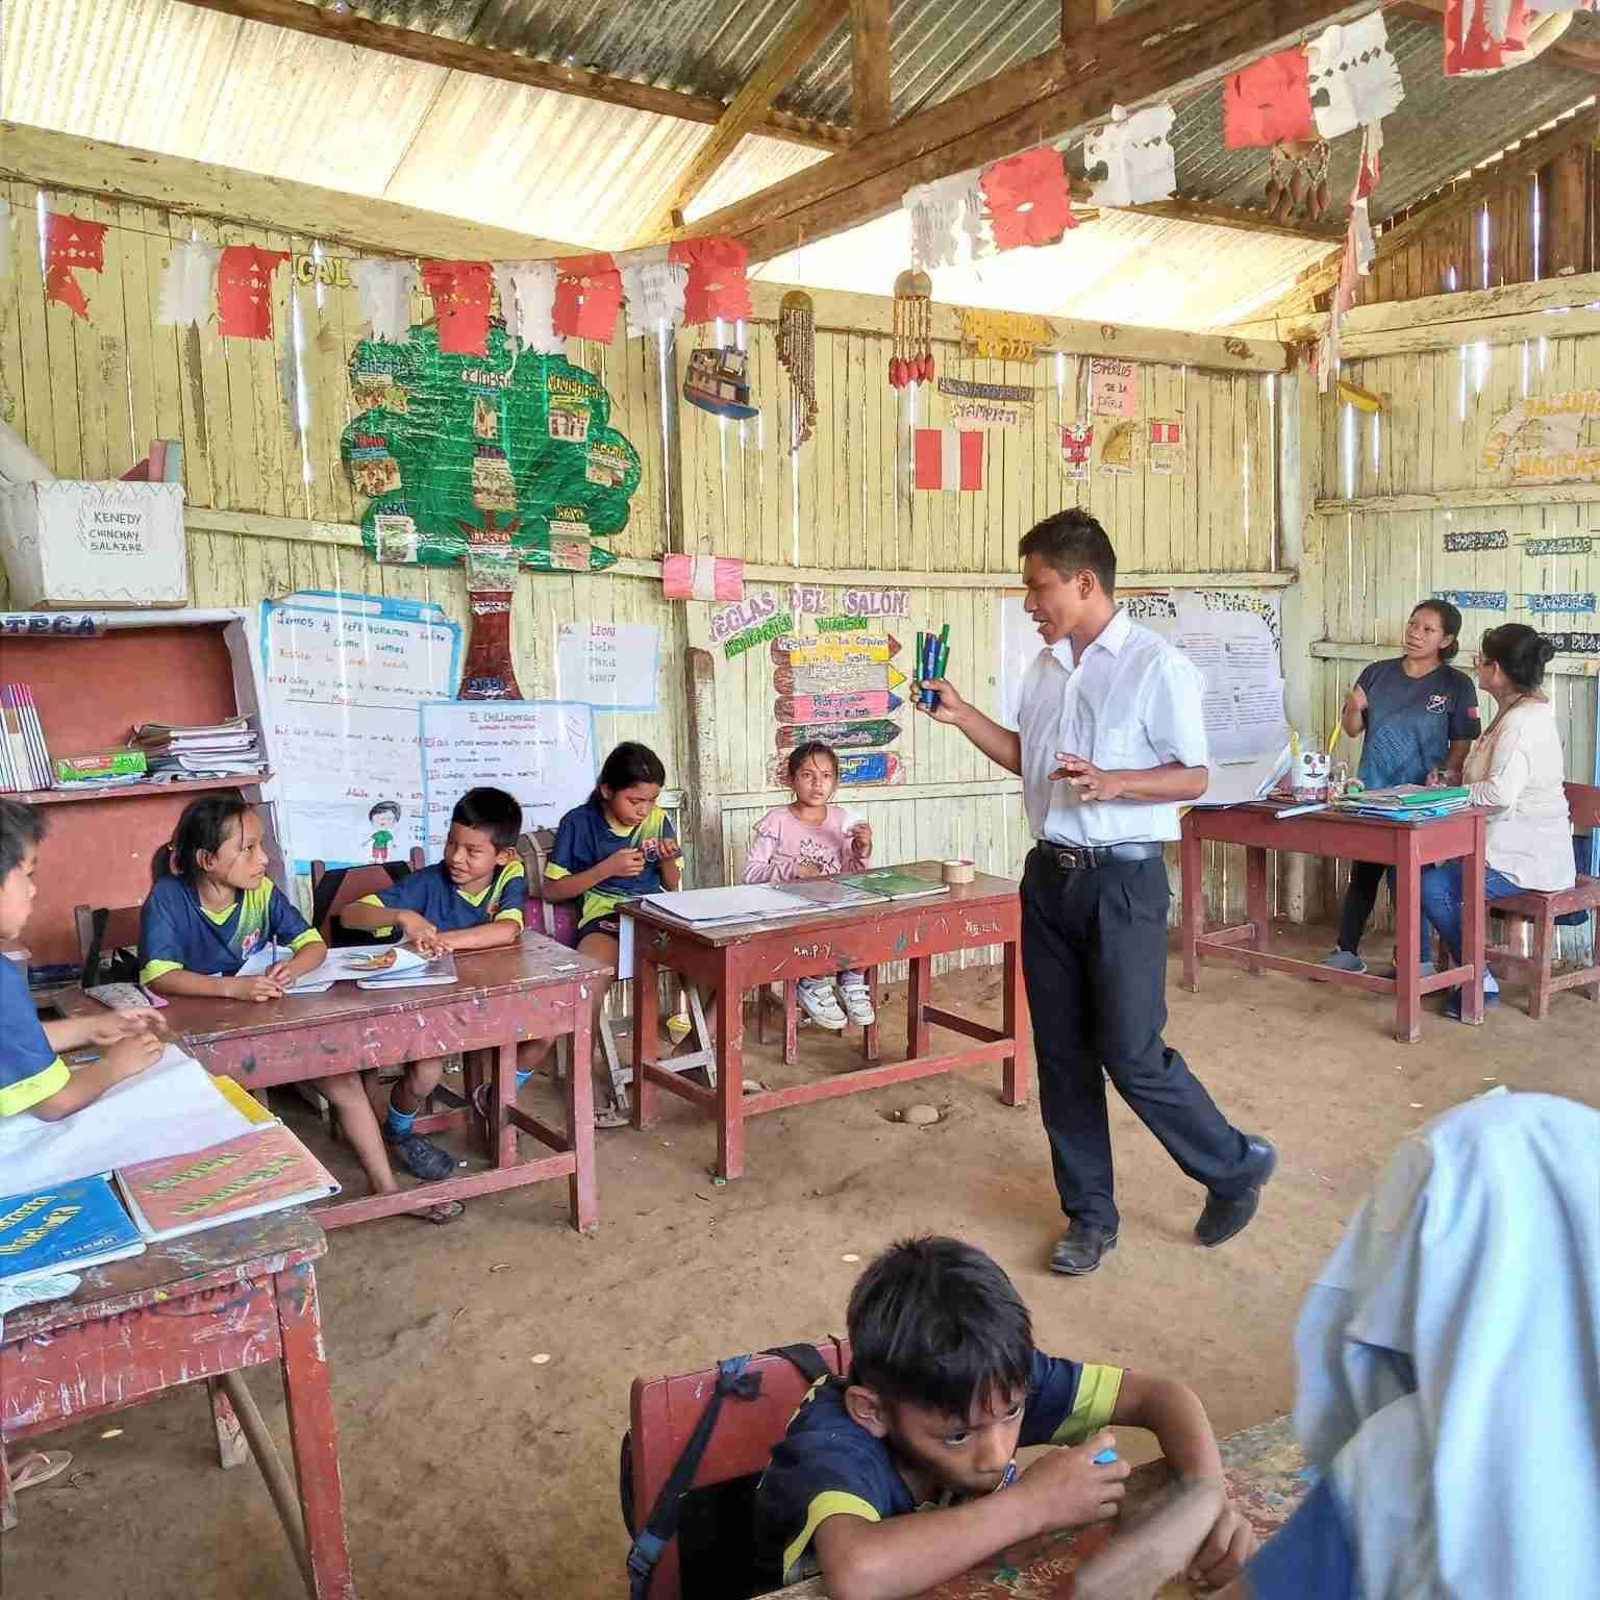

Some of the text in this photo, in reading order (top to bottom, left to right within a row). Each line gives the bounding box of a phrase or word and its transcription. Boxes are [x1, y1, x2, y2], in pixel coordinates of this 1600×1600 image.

[93, 511, 142, 525] KENEDY
[88, 528, 140, 542] CHINCHAY
[0, 615, 97, 635] TECA
